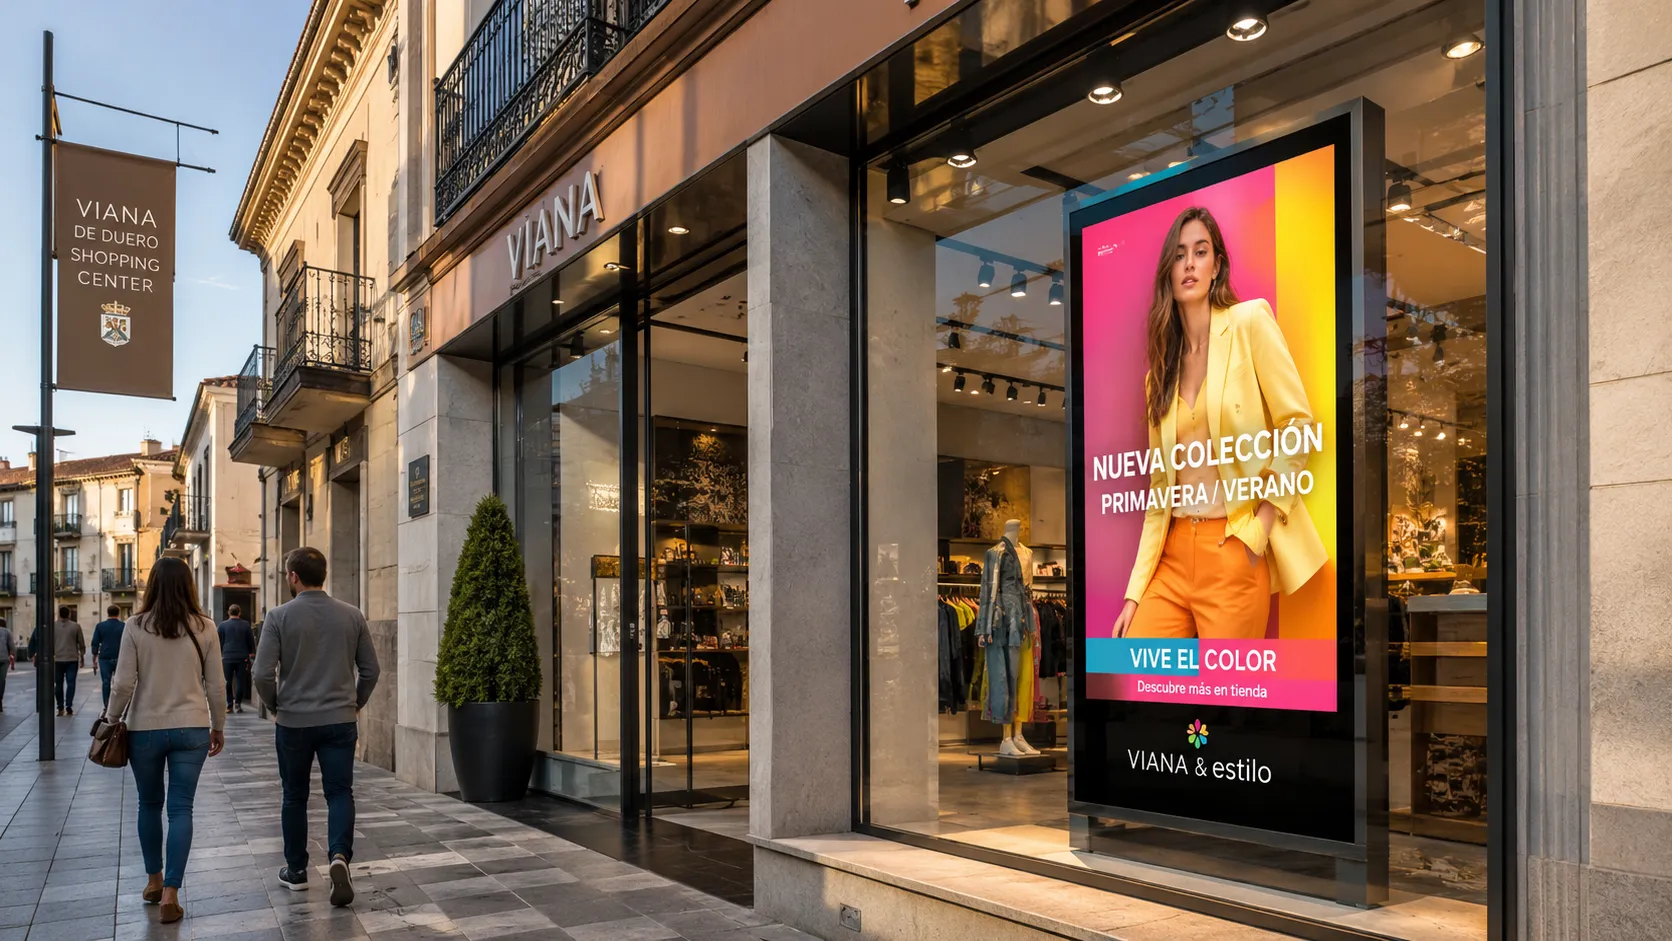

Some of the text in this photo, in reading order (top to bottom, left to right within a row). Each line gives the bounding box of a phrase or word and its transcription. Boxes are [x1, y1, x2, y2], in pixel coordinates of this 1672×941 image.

[76, 198, 157, 229] VIANA
[506, 170, 605, 280] VIANA
[74, 224, 159, 250] DE DUERO
[70, 247, 160, 272] SHOPPING
[77, 270, 153, 293] CENTER
[1093, 418, 1323, 481] NUEVA COLECCIÓN
[1101, 470, 1314, 515] PRIMAVERA / VERANO
[1130, 648, 1276, 672] VIVE EL COLOR
[1137, 680, 1267, 698] Descubre más en tienda
[1127, 748, 1272, 784] VIANA & estilo
